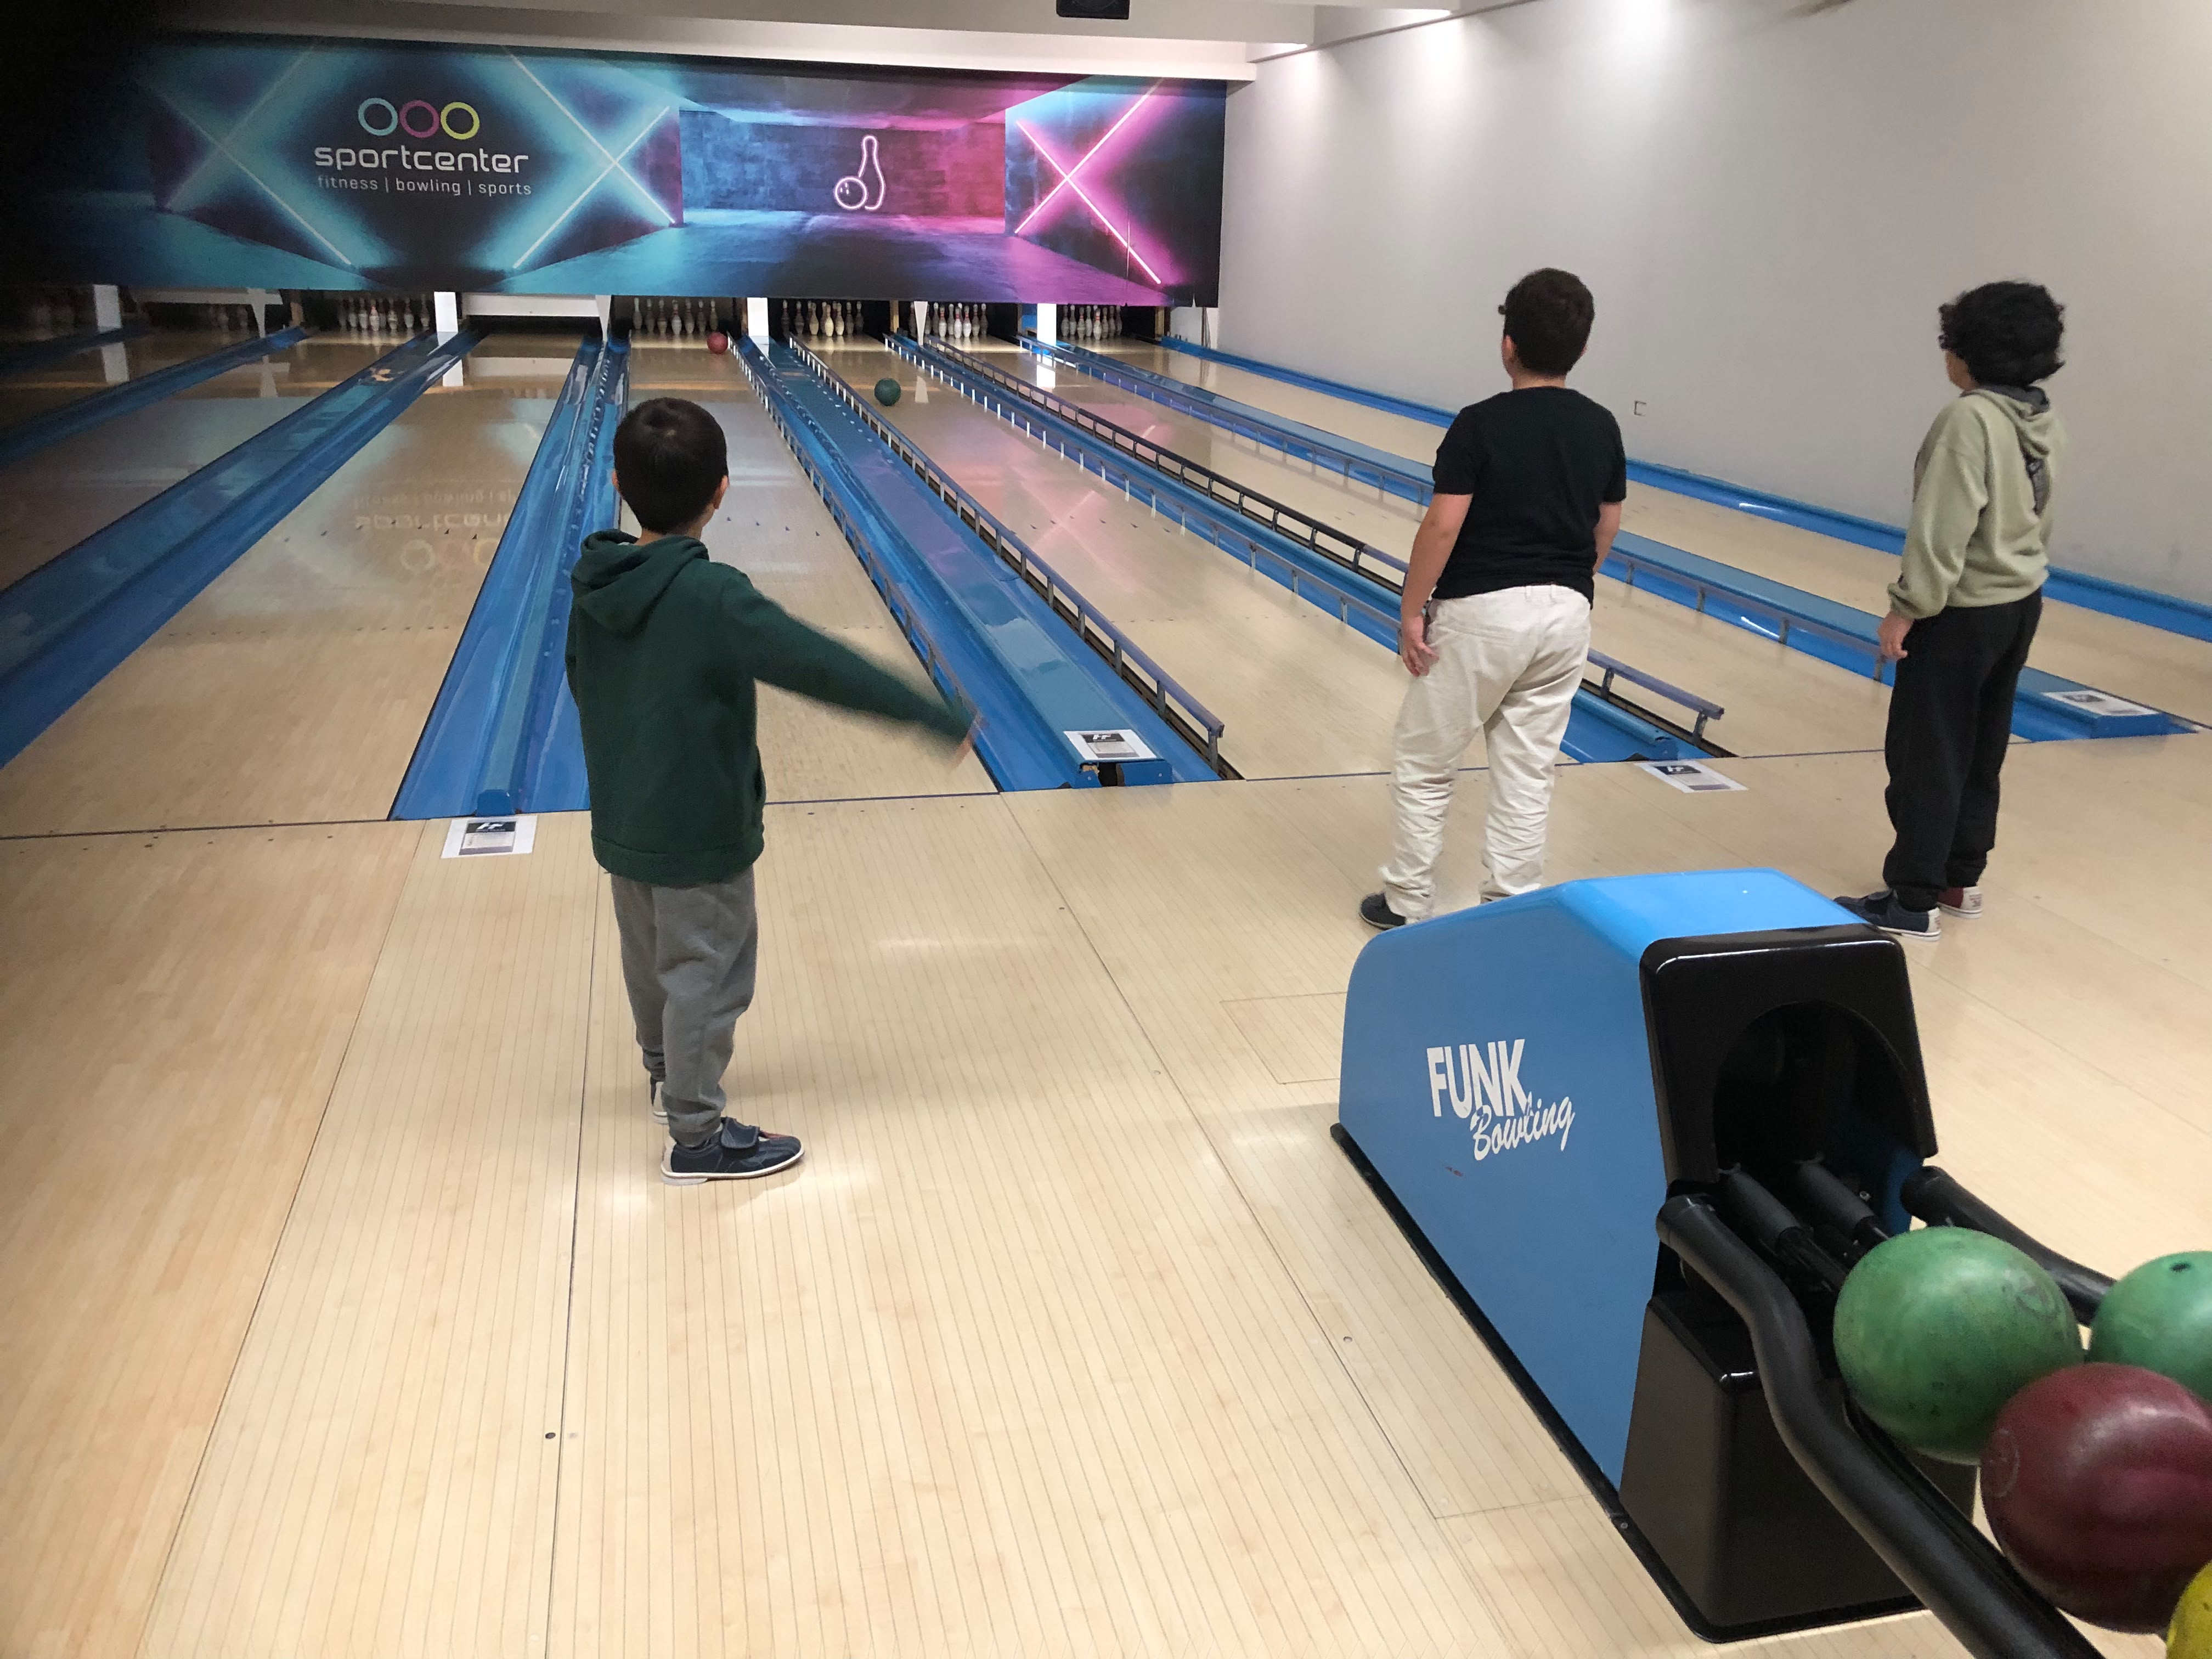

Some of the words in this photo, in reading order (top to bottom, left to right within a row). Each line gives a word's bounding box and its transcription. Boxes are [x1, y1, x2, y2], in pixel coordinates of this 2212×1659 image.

[314, 145, 528, 173] sportcenter
[318, 175, 378, 190] fitness
[396, 178, 460, 196] bowling
[478, 183, 532, 197] sports
[1427, 1039, 1534, 1118] FUNK
[1470, 1091, 1576, 1160] Bowling
